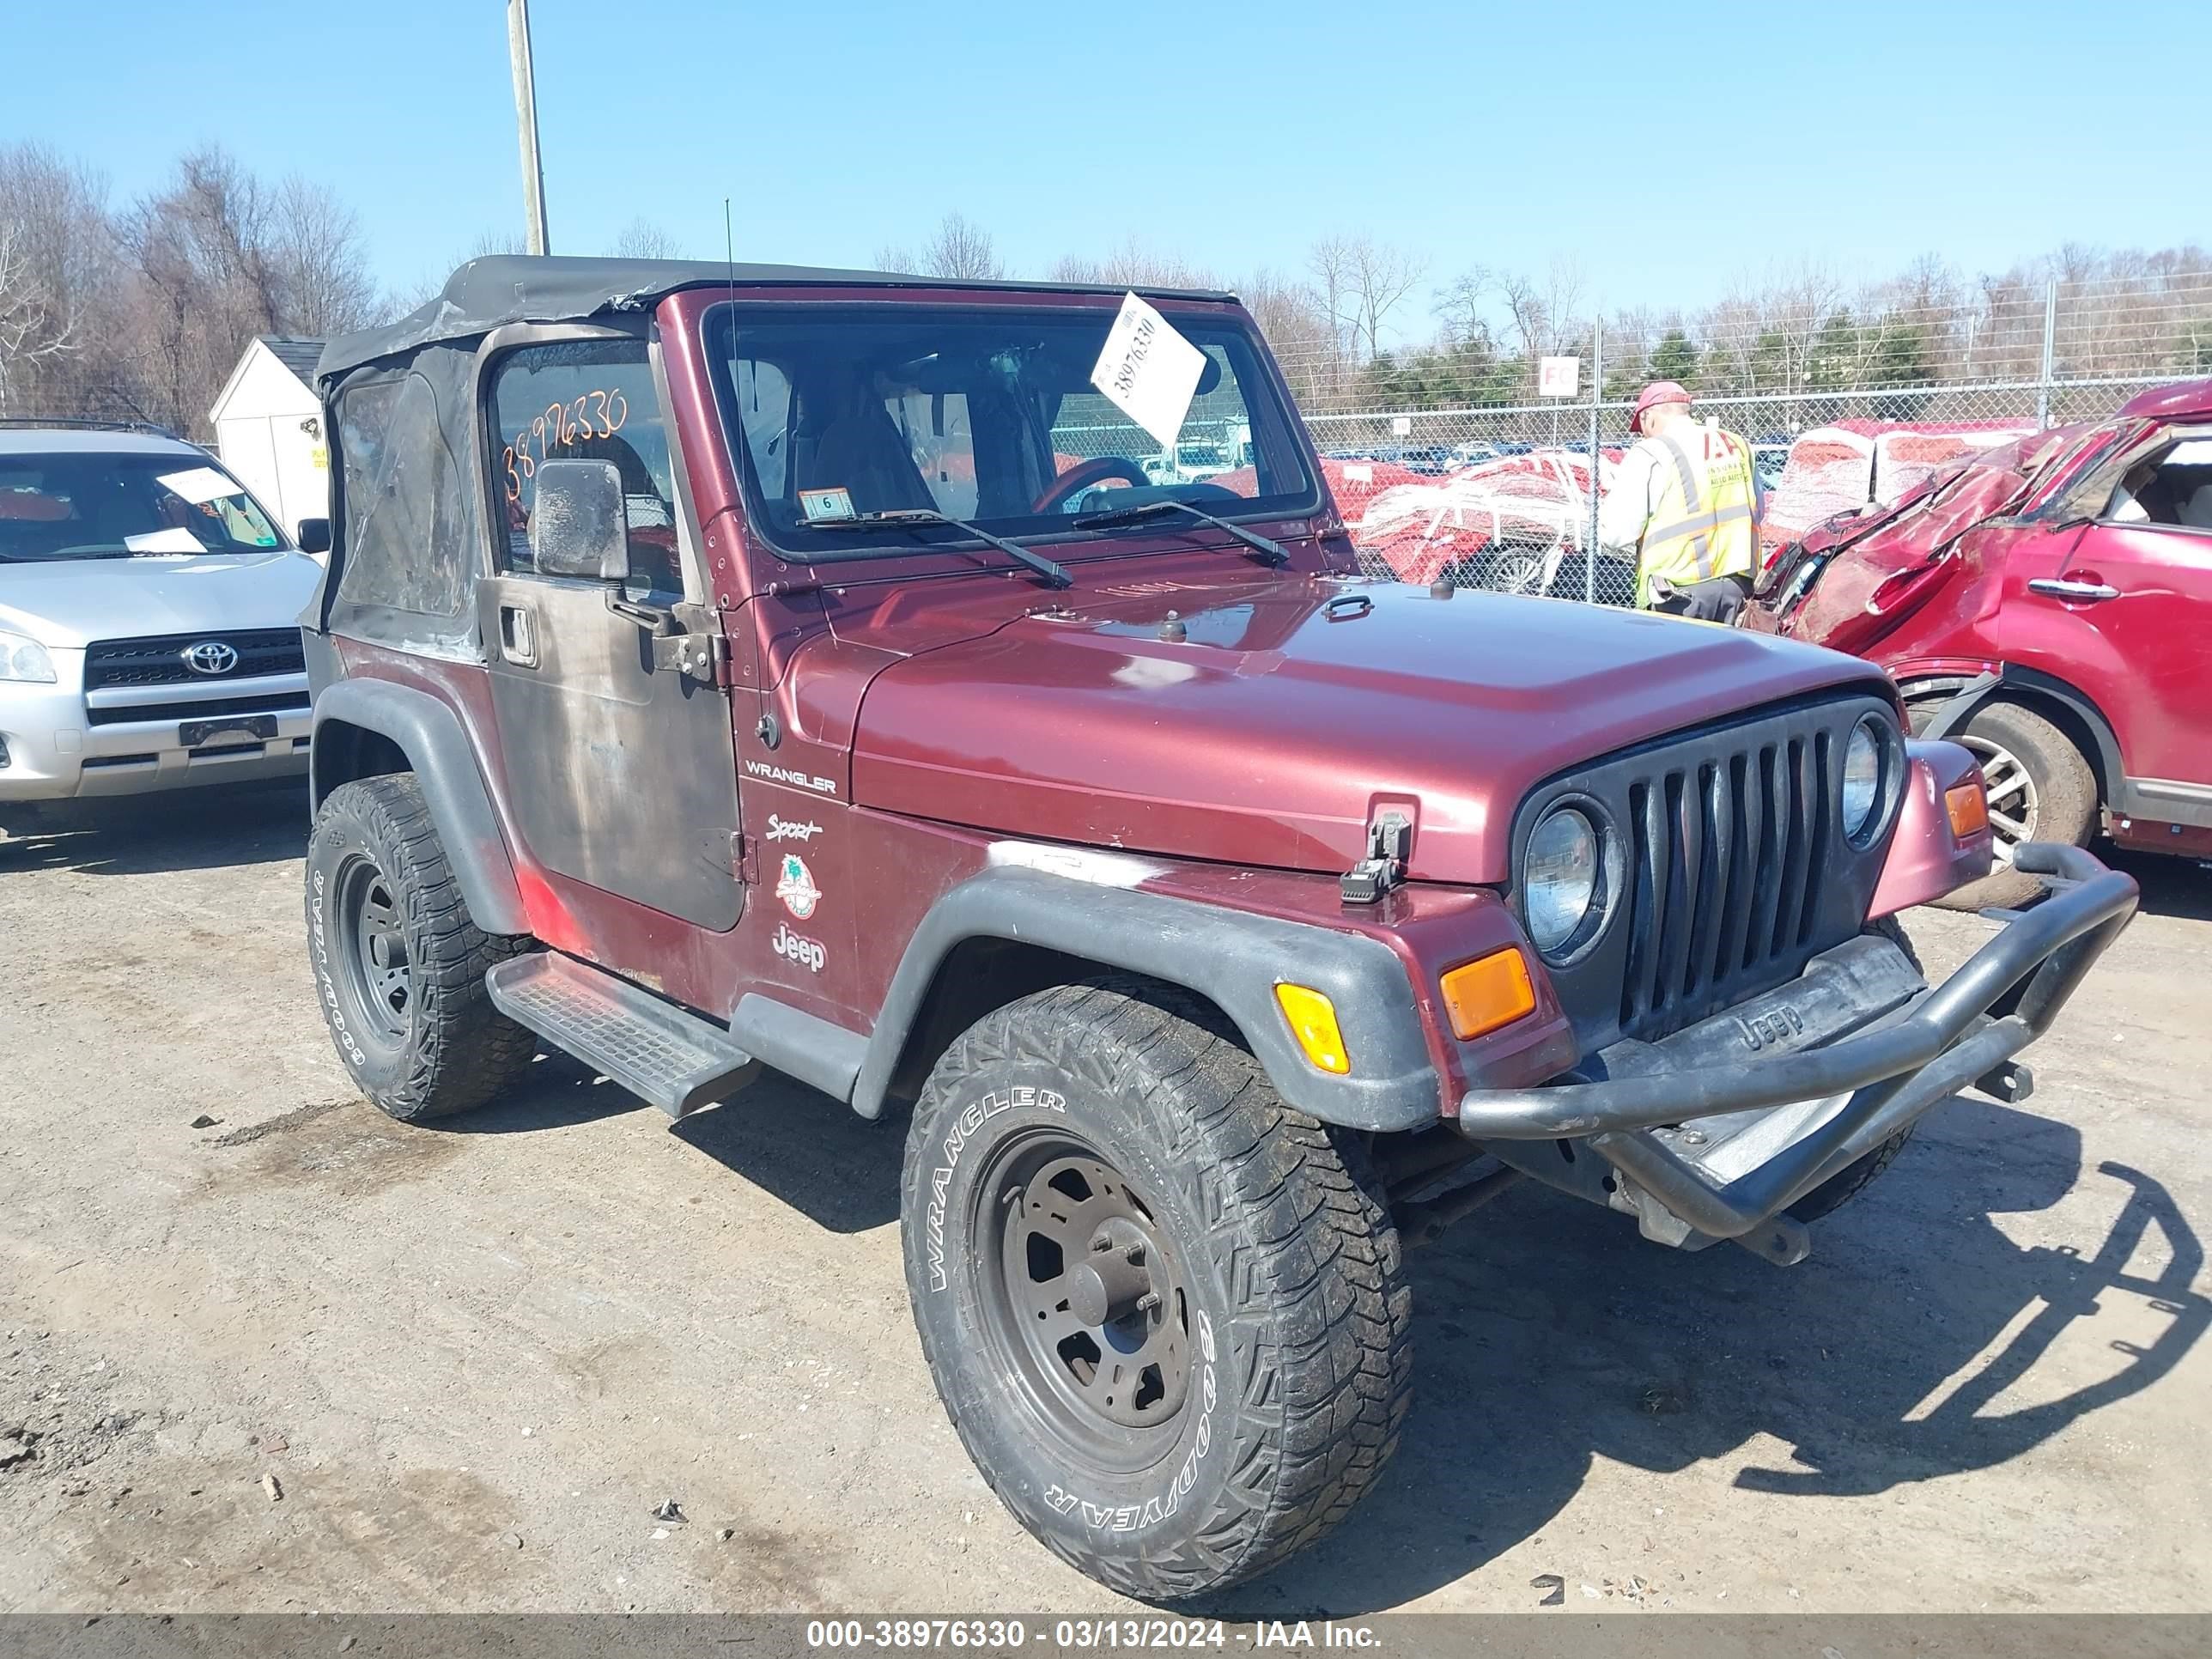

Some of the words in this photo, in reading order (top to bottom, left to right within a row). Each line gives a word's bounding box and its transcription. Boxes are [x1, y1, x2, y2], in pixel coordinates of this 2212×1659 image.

[1114, 318, 1156, 398] 38976330
[502, 388, 627, 501] 38976330
[823, 496, 832, 509] 6
[745, 759, 837, 794] WRANGLER
[765, 812, 823, 843] Sport
[312, 870, 366, 1066] GOODYEAR
[772, 924, 824, 973] Jeep
[1735, 1006, 1804, 1051] Jeep
[927, 1087, 1067, 1293] WRANGLER
[1044, 1309, 1217, 1532] GOODYEAR
